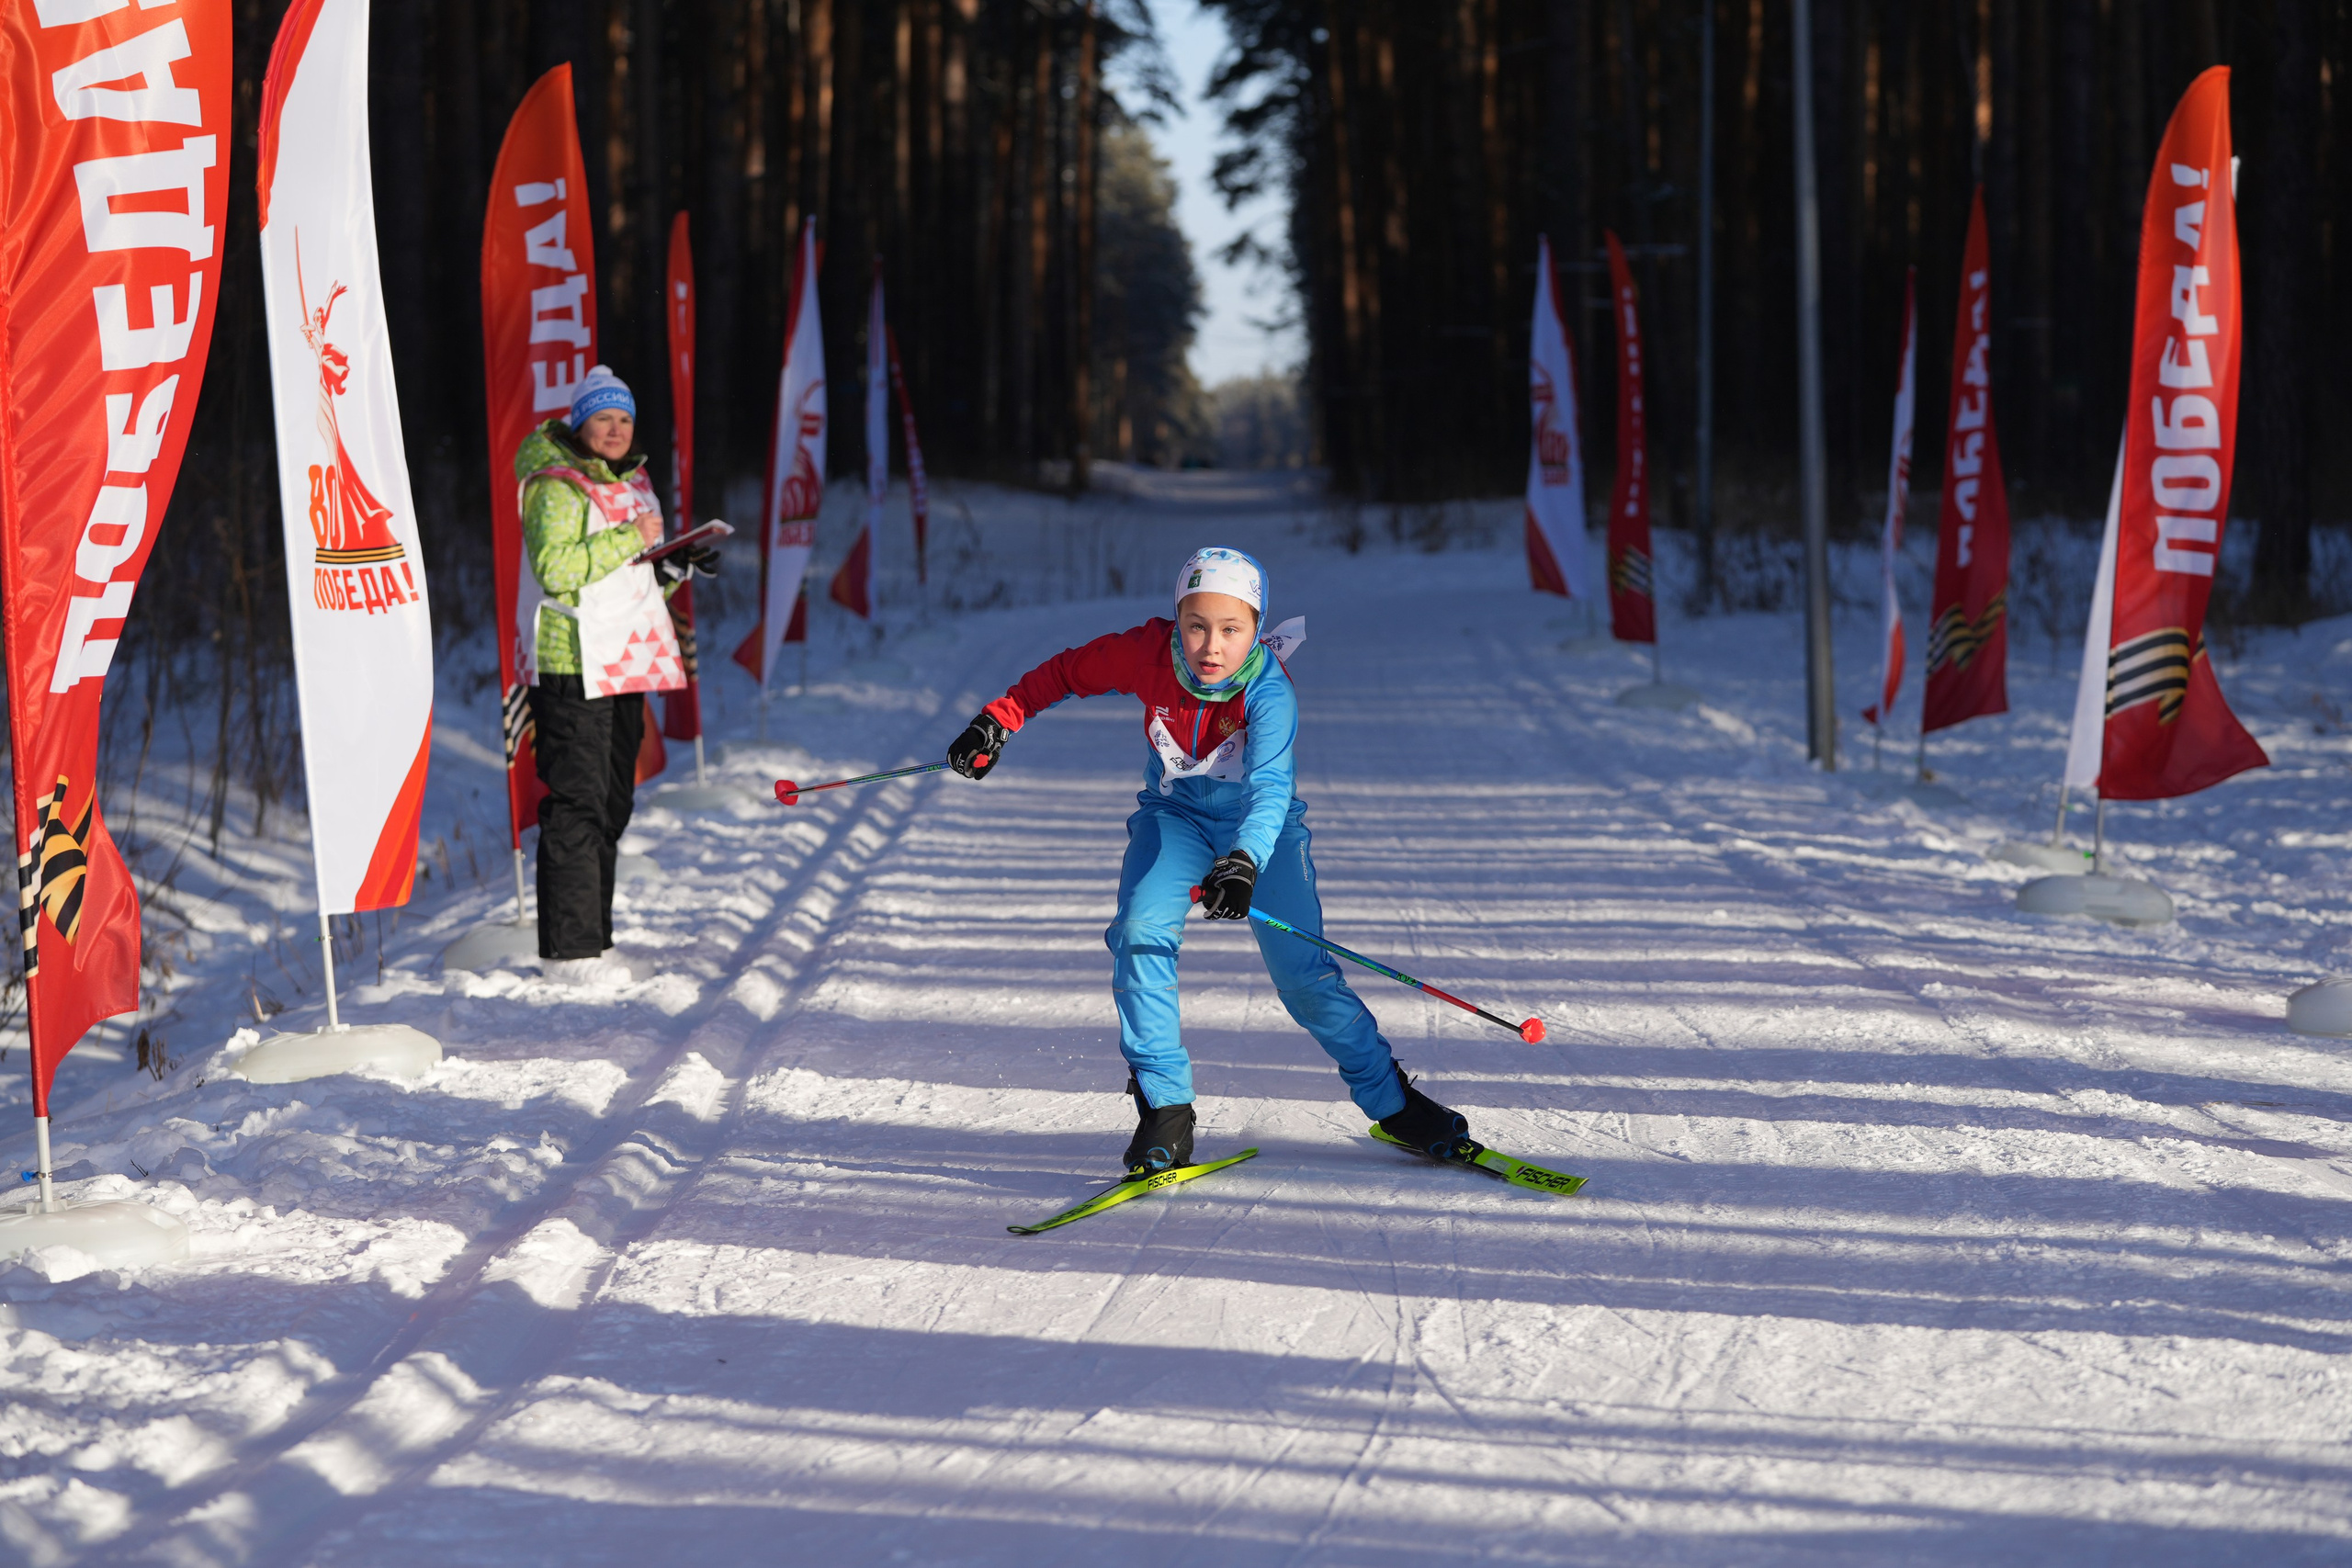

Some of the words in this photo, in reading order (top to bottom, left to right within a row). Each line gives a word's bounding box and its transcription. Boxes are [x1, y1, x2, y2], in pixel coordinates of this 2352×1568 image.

[33, 0, 217, 694] ПОБЕДА
[514, 178, 591, 421] ЕДА!
[2151, 163, 2222, 576] ПОБЕДА!
[314, 561, 420, 615] ПОБЕДА!
[1148, 1172, 1177, 1190] FISCHER
[1516, 1168, 1571, 1190] FISCHER
